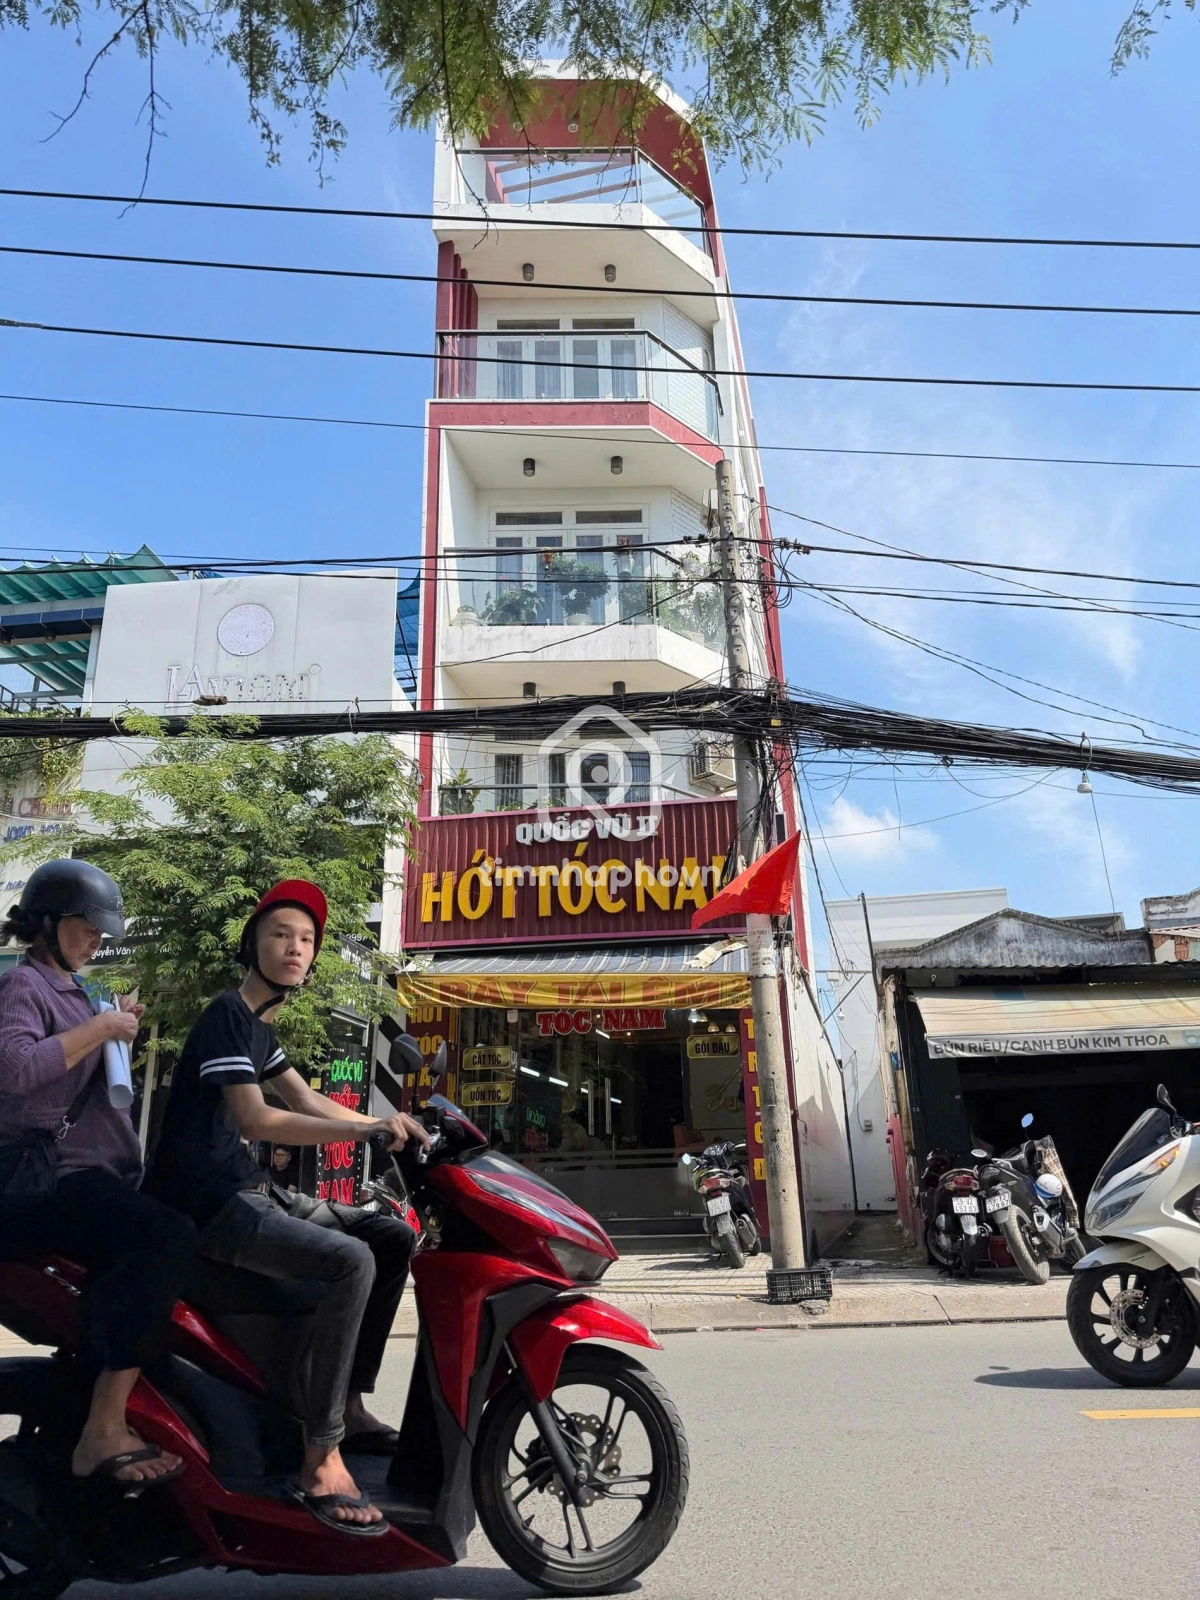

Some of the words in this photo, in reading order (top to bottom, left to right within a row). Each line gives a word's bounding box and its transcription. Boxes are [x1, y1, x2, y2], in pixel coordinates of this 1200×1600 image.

[516, 812, 591, 846] QUỐC
[595, 813, 631, 839] VŨ
[421, 849, 524, 922] HỚT
[532, 842, 627, 917] TÓC
[552, 979, 625, 1005] TAI
[642, 975, 724, 1005] ÊM
[536, 1008, 592, 1036] TÓC
[602, 1007, 666, 1032] NAM
[934, 1041, 965, 1055] BÚN
[1057, 1035, 1090, 1050] BÚN
[1092, 1036, 1121, 1048] KIM
[1124, 1034, 1170, 1047] THOA
[319, 1176, 355, 1205] NAM
